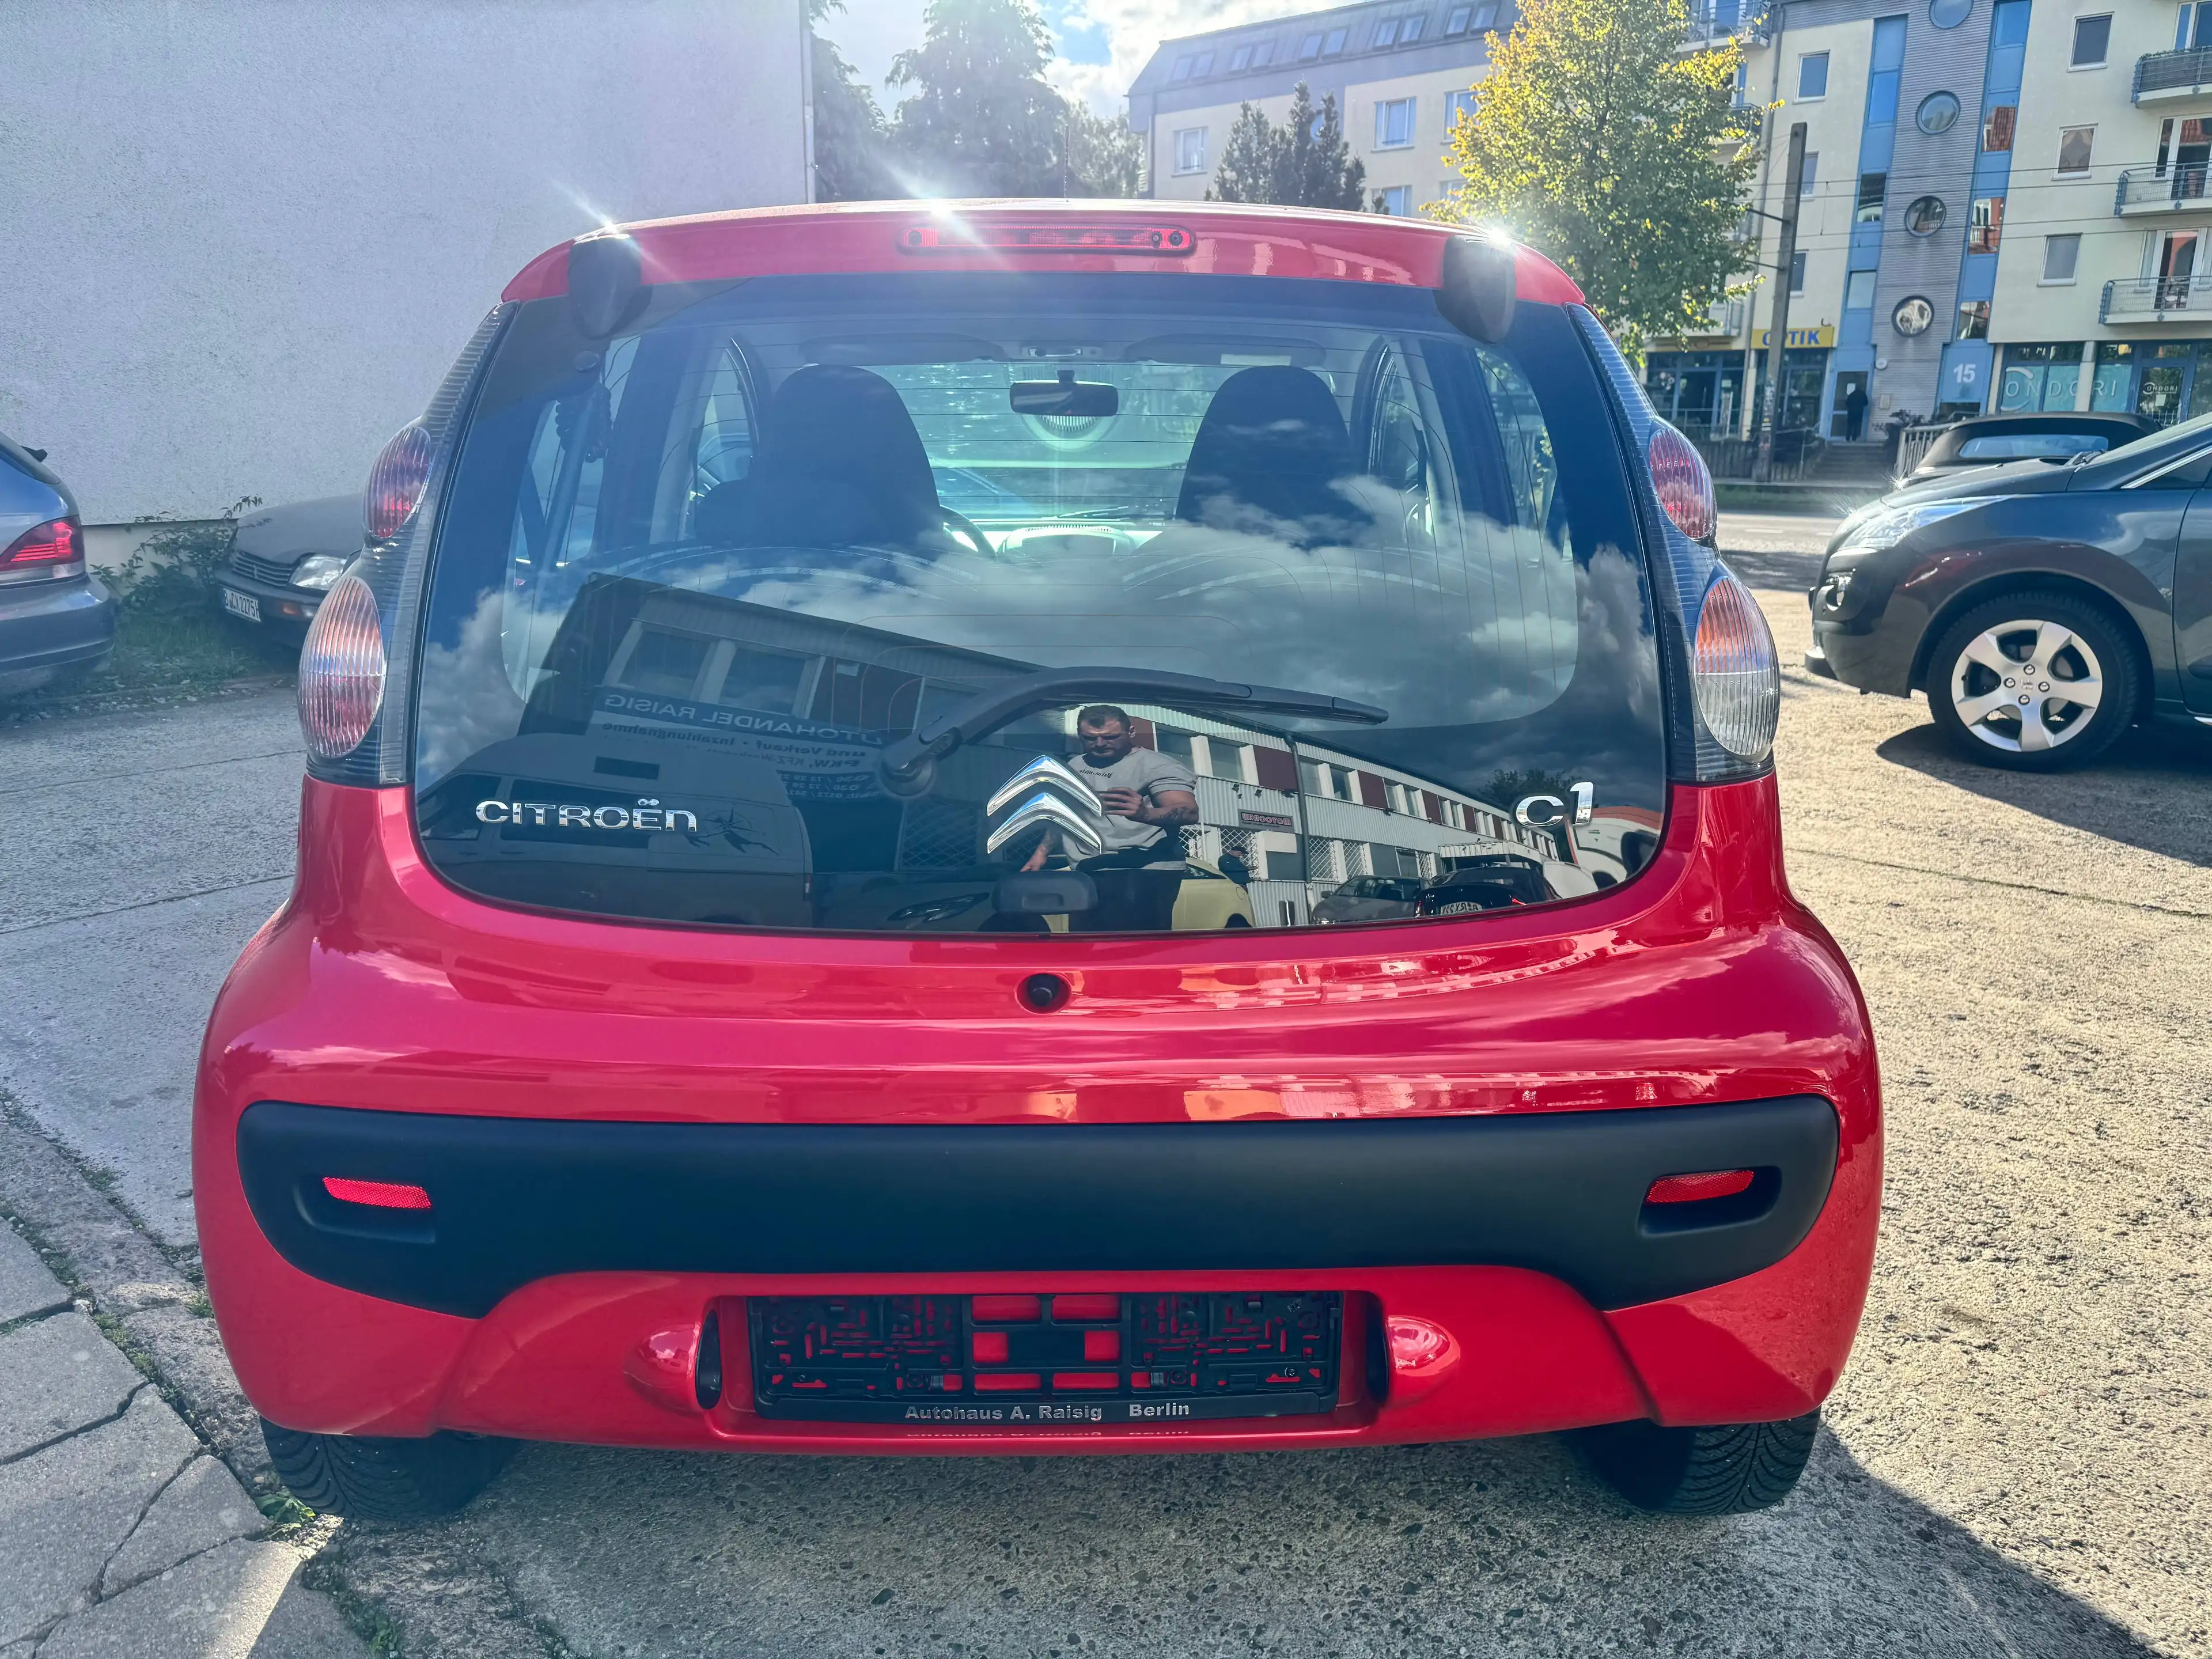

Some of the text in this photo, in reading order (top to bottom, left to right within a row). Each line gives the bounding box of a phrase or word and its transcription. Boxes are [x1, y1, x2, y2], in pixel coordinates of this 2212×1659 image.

[1762, 331, 1820, 346] OTIK
[1953, 363, 1976, 384] 15
[905, 1402, 1190, 1421] Autohaus A. Raisig Berlin
